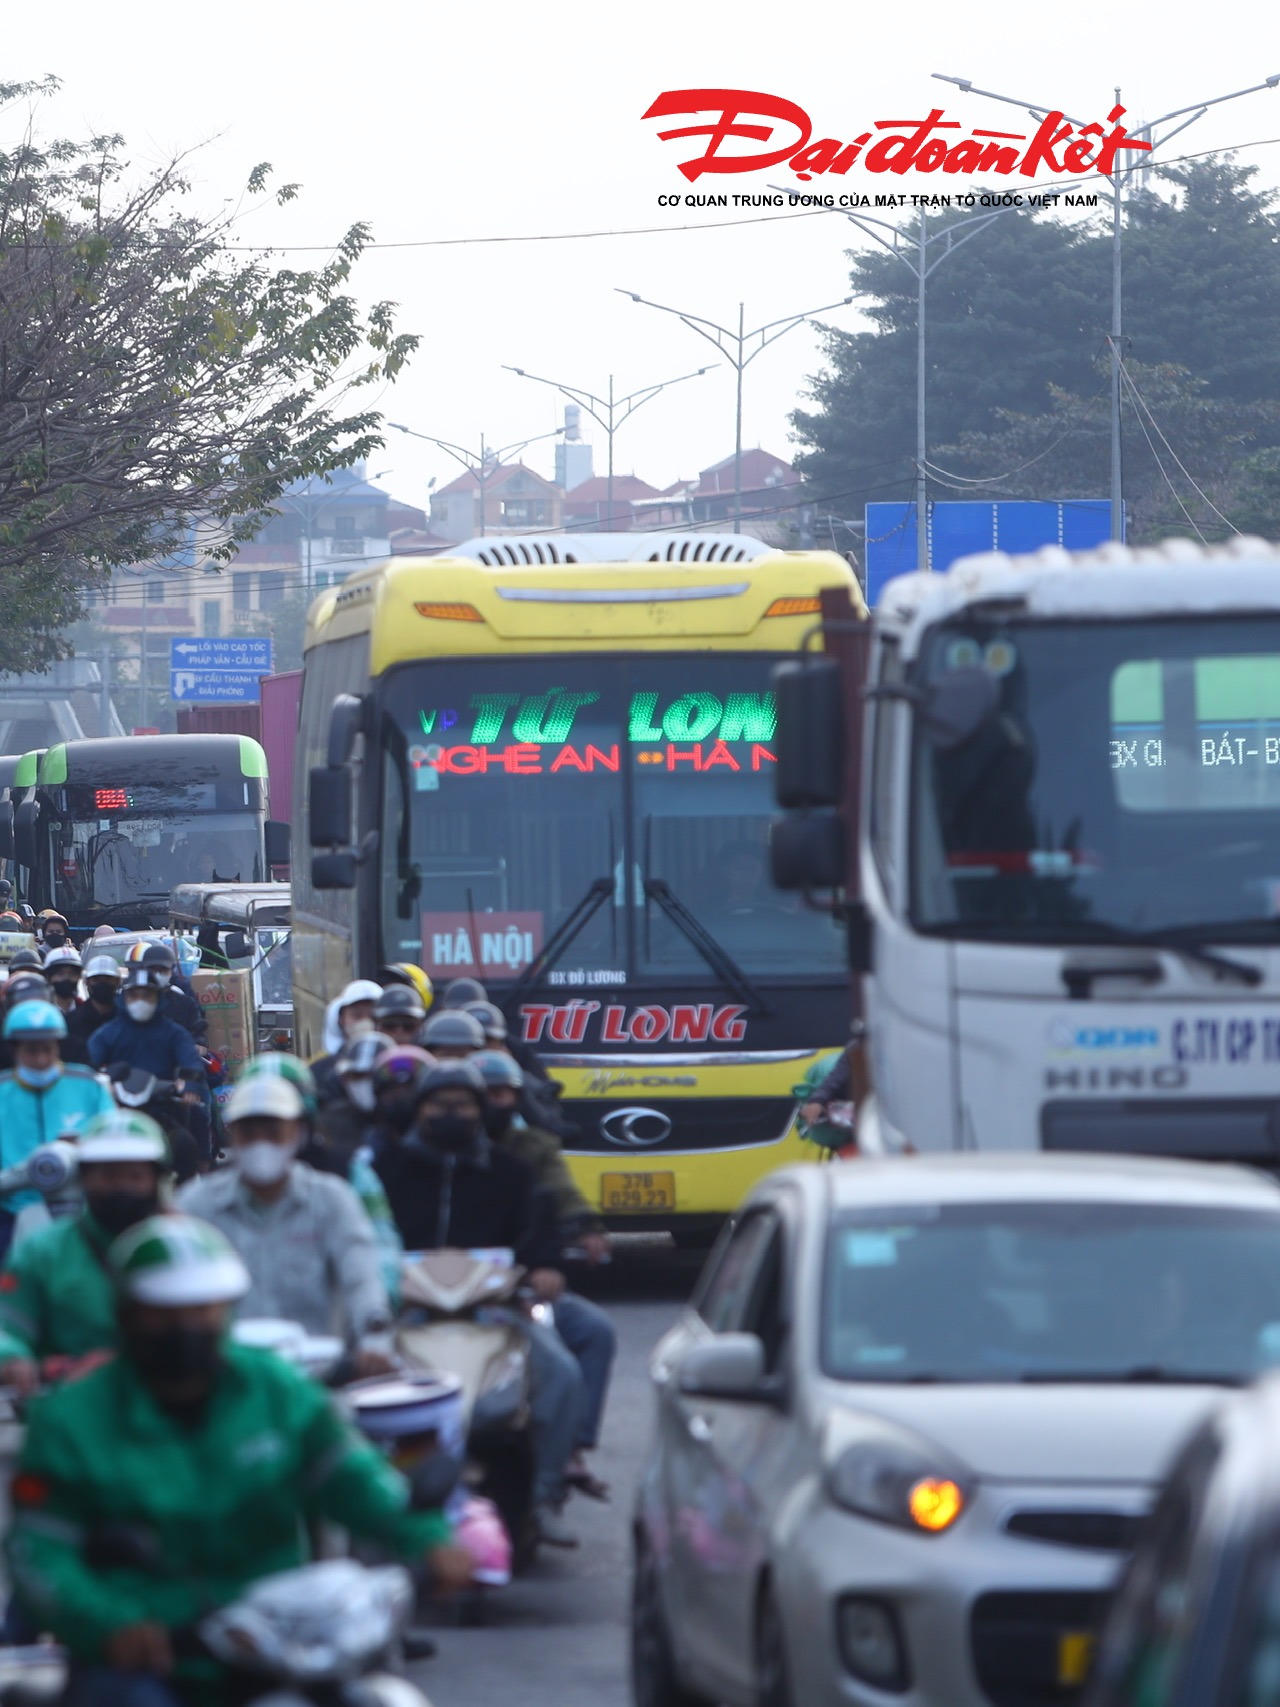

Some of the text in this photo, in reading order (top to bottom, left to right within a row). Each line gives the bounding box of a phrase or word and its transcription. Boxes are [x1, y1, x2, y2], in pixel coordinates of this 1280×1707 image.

[231, 642, 247, 652] CAO
[629, 691, 777, 742] LON
[550, 744, 619, 773] AN
[433, 924, 534, 969] HÀ NỘI
[602, 1004, 748, 1043] LONG
[1043, 1066, 1189, 1089] HINO
